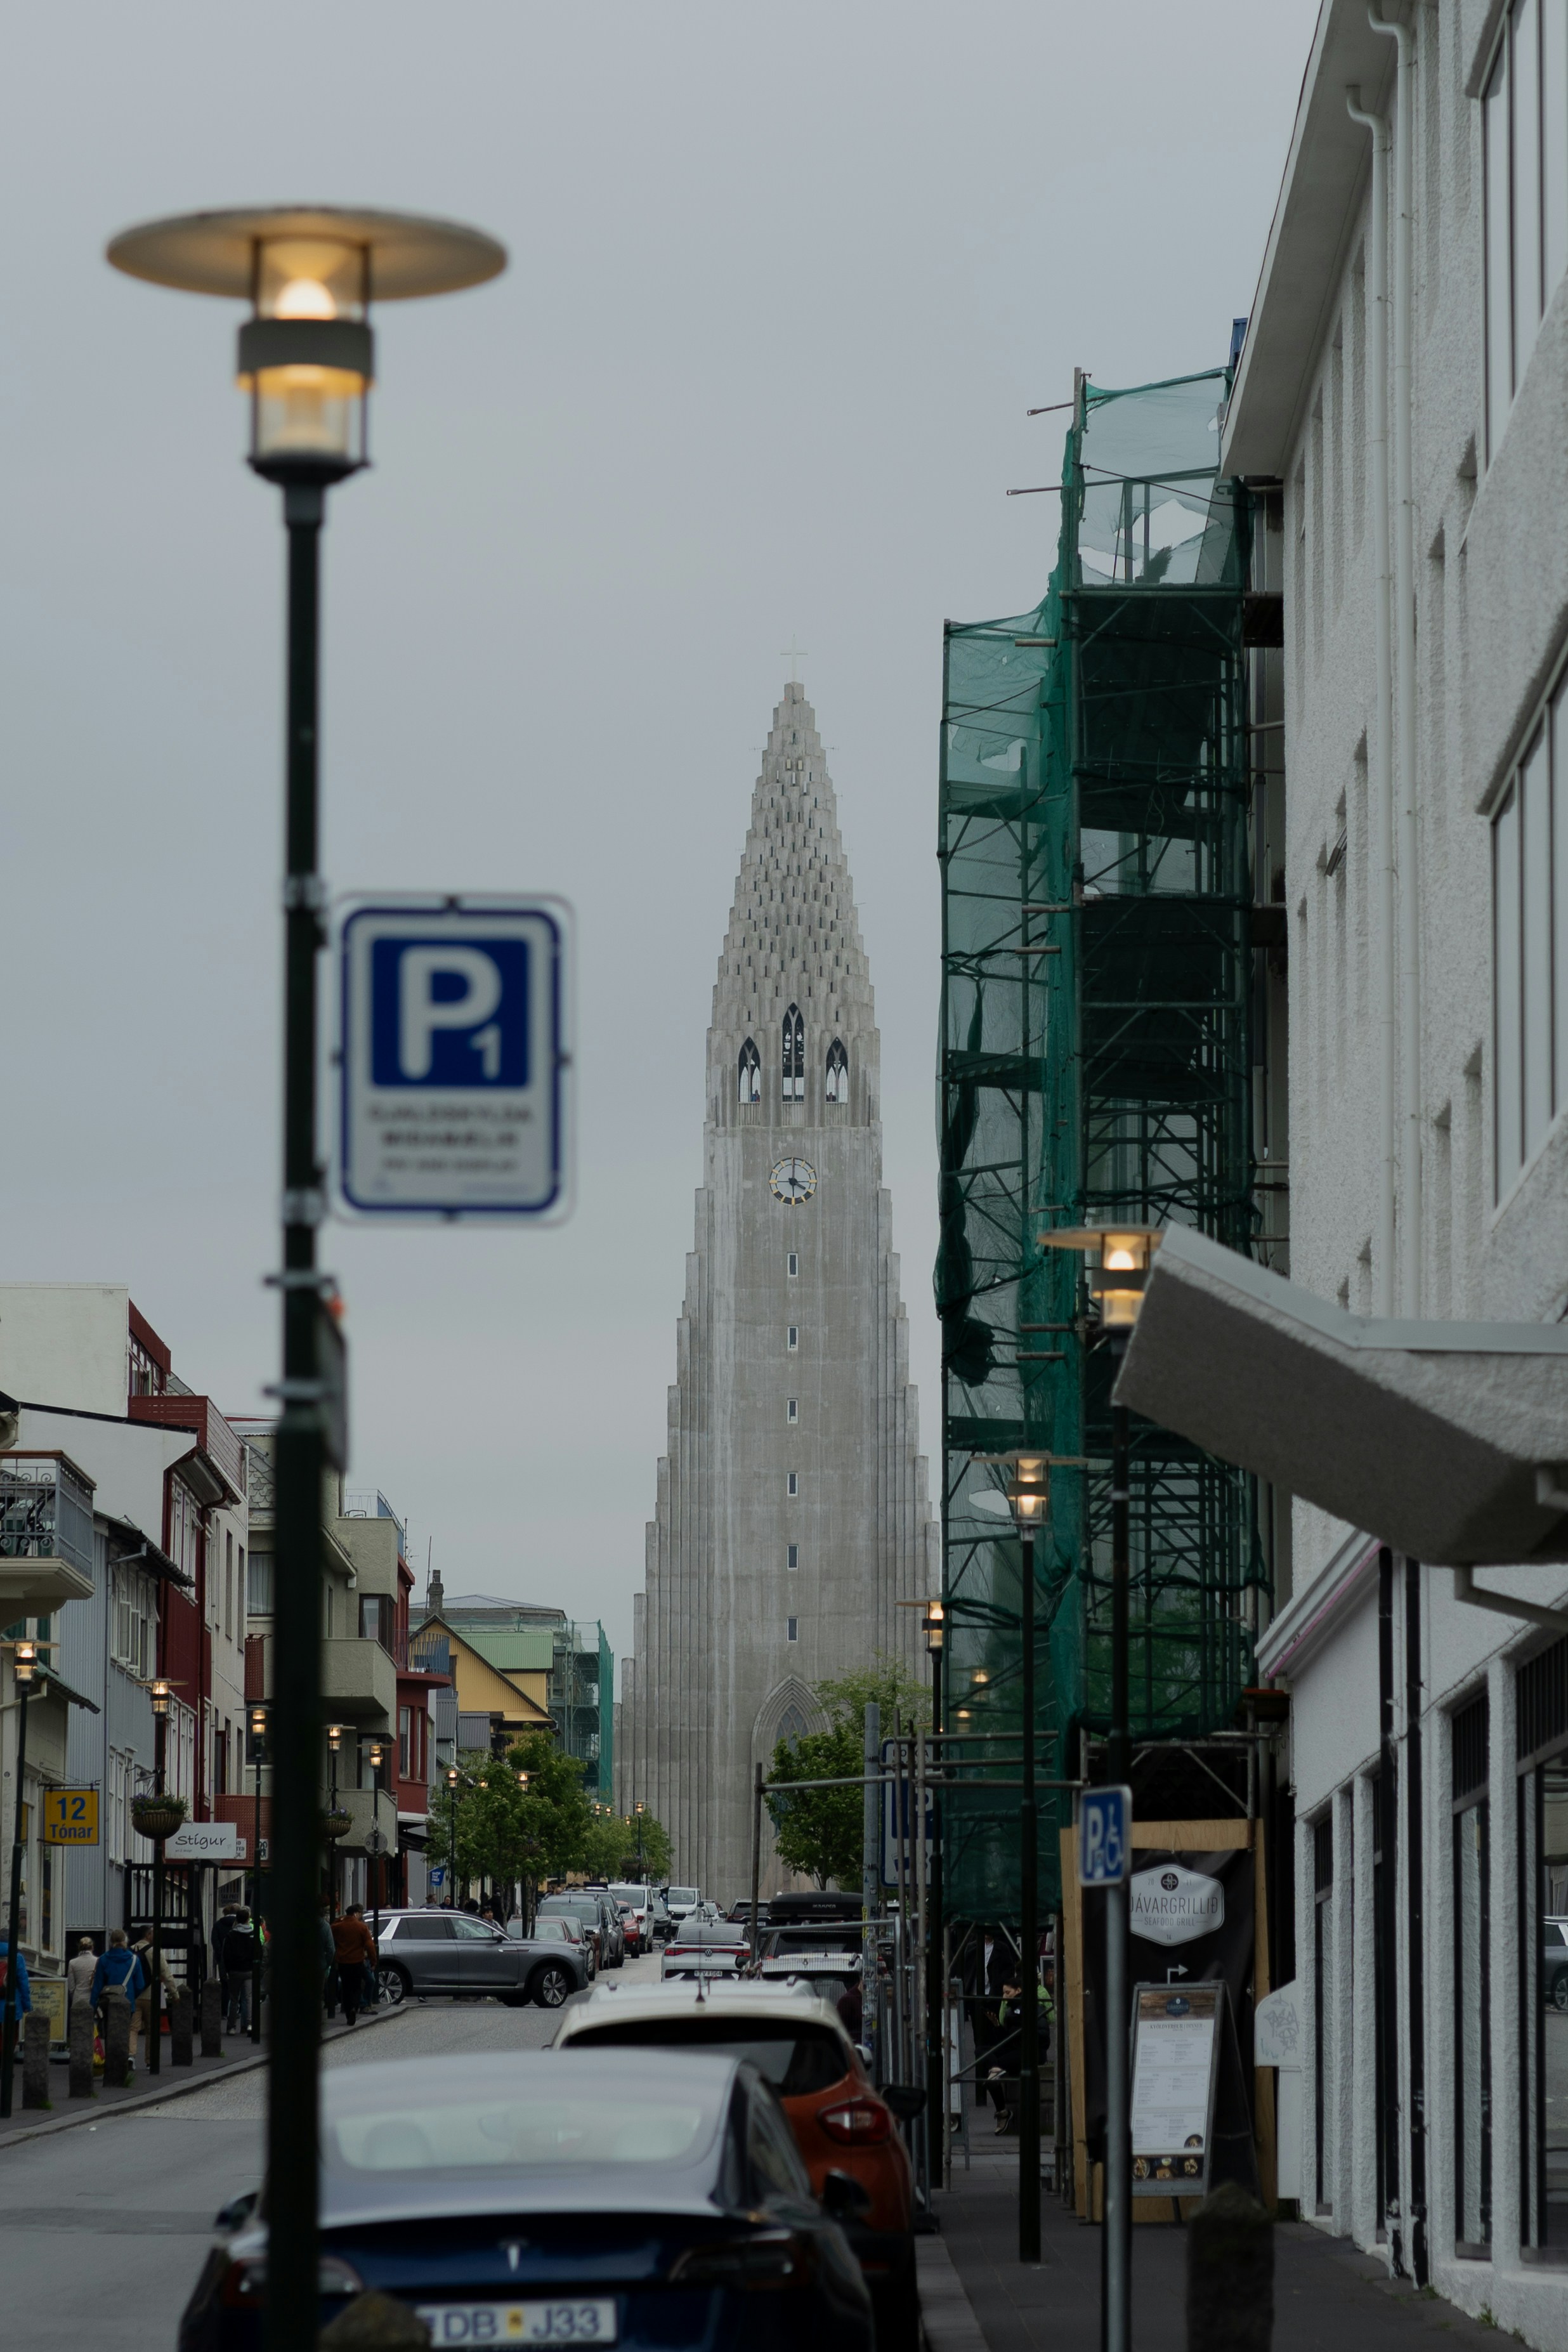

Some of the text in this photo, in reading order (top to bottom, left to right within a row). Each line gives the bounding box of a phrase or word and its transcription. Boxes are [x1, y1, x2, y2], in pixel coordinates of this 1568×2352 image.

[56, 1796, 86, 1819] 12
[50, 1823, 93, 1839] Tónar
[175, 1833, 226, 1850] Stígur
[1144, 1917, 1195, 1927] SEAFOOD GRILL
[443, 2306, 600, 2339] DB J33
